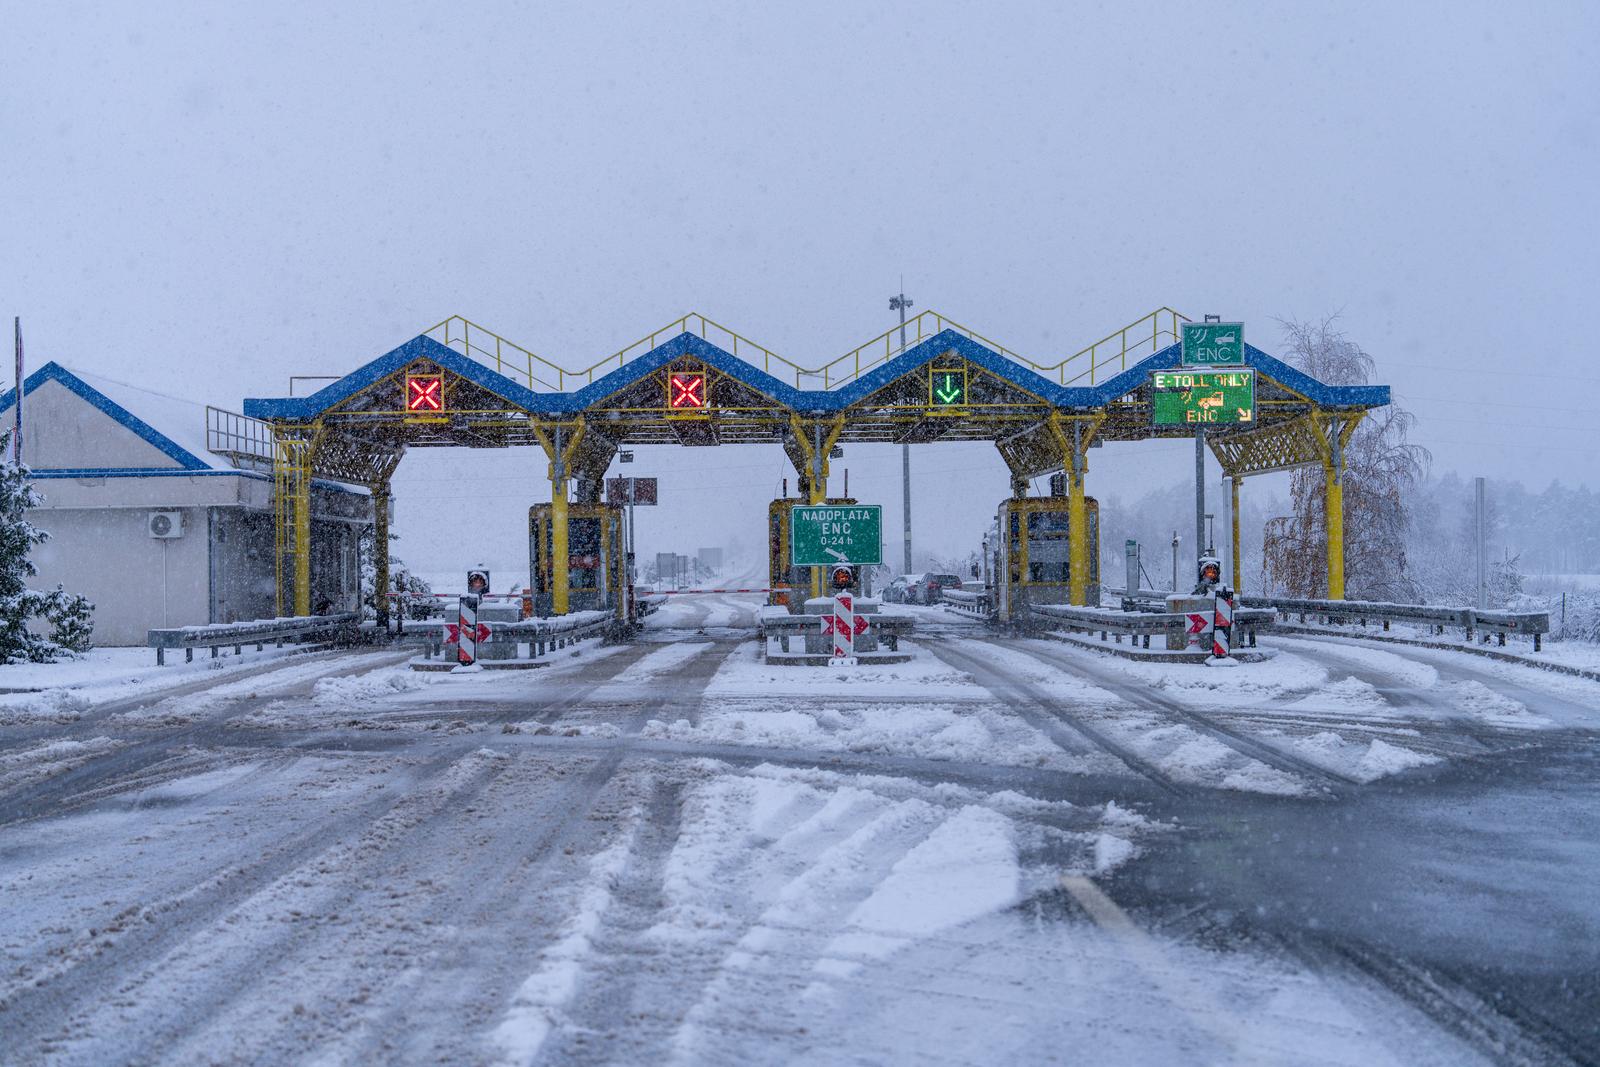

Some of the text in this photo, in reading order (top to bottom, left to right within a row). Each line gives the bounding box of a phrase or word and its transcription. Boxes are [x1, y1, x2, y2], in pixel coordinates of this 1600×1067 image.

[1197, 347, 1231, 361] ENC
[1186, 410, 1218, 422] ENC
[802, 510, 870, 521] NADOPLATA
[822, 522, 851, 535] ENC
[820, 536, 853, 545] 0-24 h
